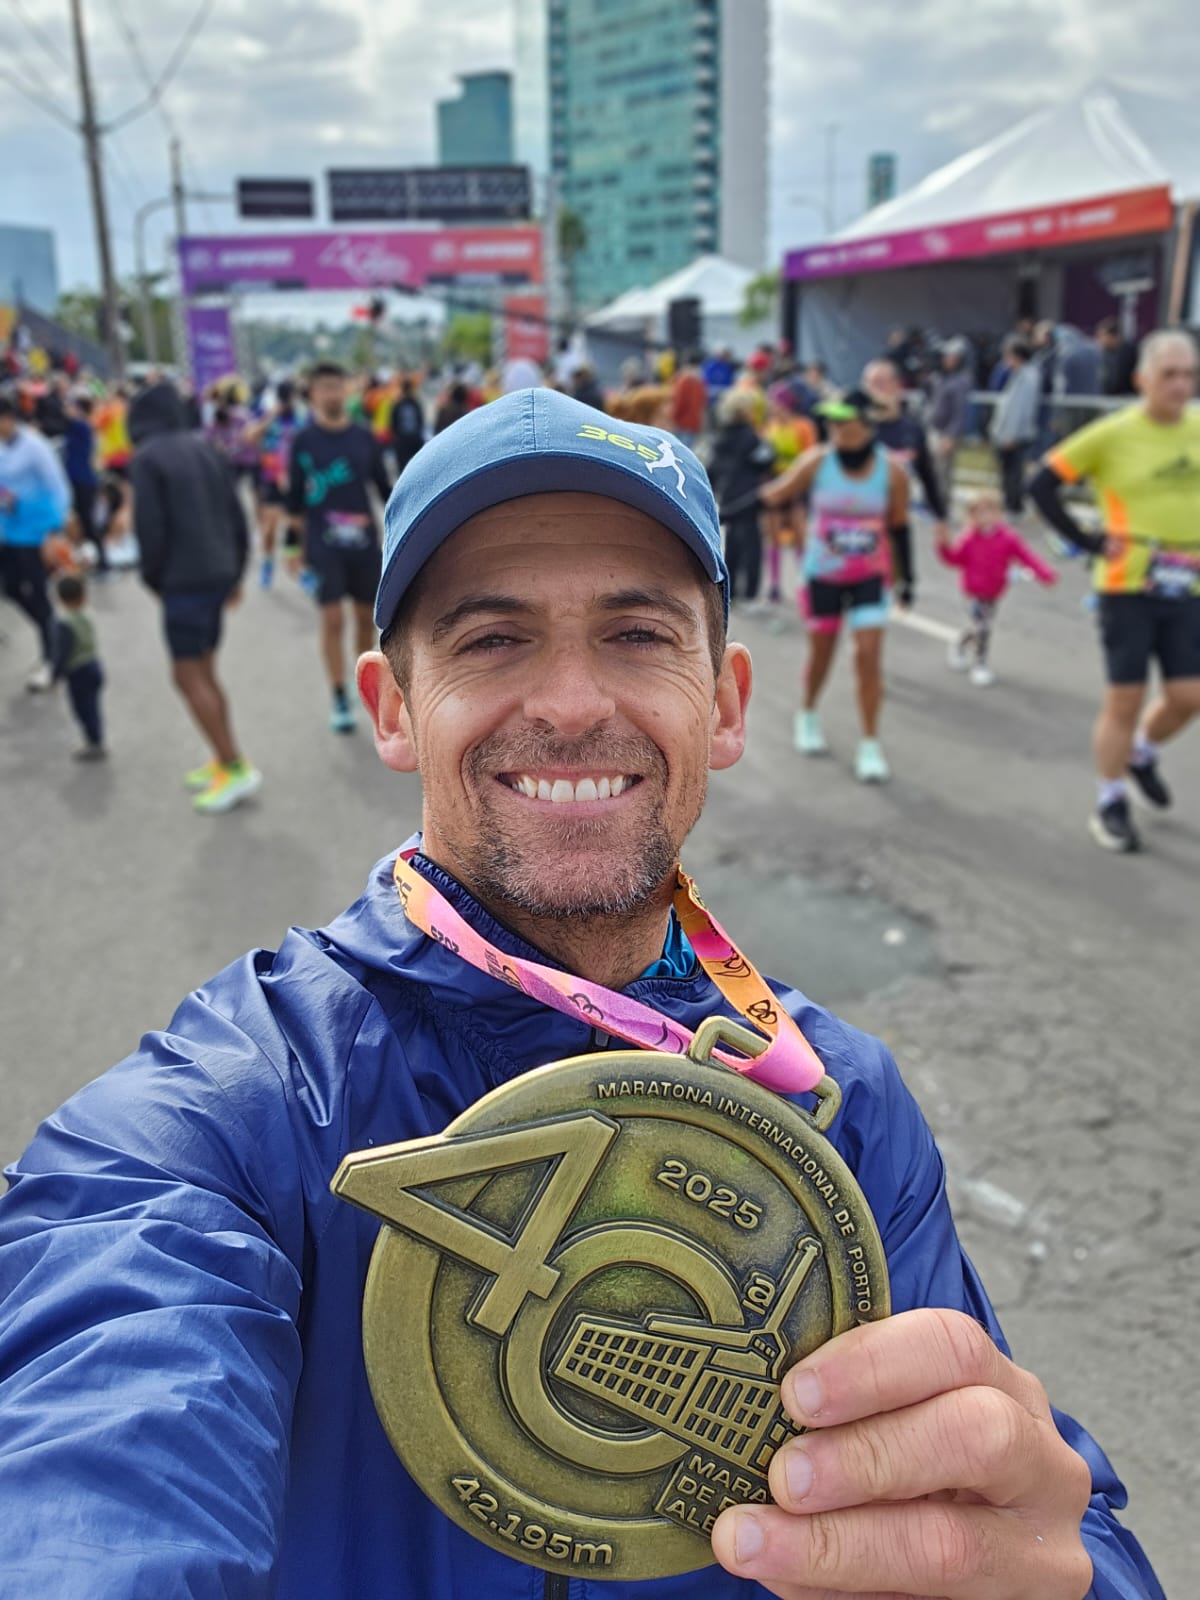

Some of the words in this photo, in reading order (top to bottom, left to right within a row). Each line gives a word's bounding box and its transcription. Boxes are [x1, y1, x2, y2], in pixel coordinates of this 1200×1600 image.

[575, 423, 661, 461] 365
[597, 1080, 713, 1107] MARATONA
[717, 1096, 841, 1209] INTERNACIONAL
[834, 1209, 856, 1237] DE
[848, 1246, 872, 1313] PORTO
[656, 1159, 763, 1230] 2025
[677, 1475, 716, 1505] DE
[688, 1454, 768, 1504] MARA
[451, 1477, 613, 1565] 42.195m
[665, 1499, 717, 1533] ALE
